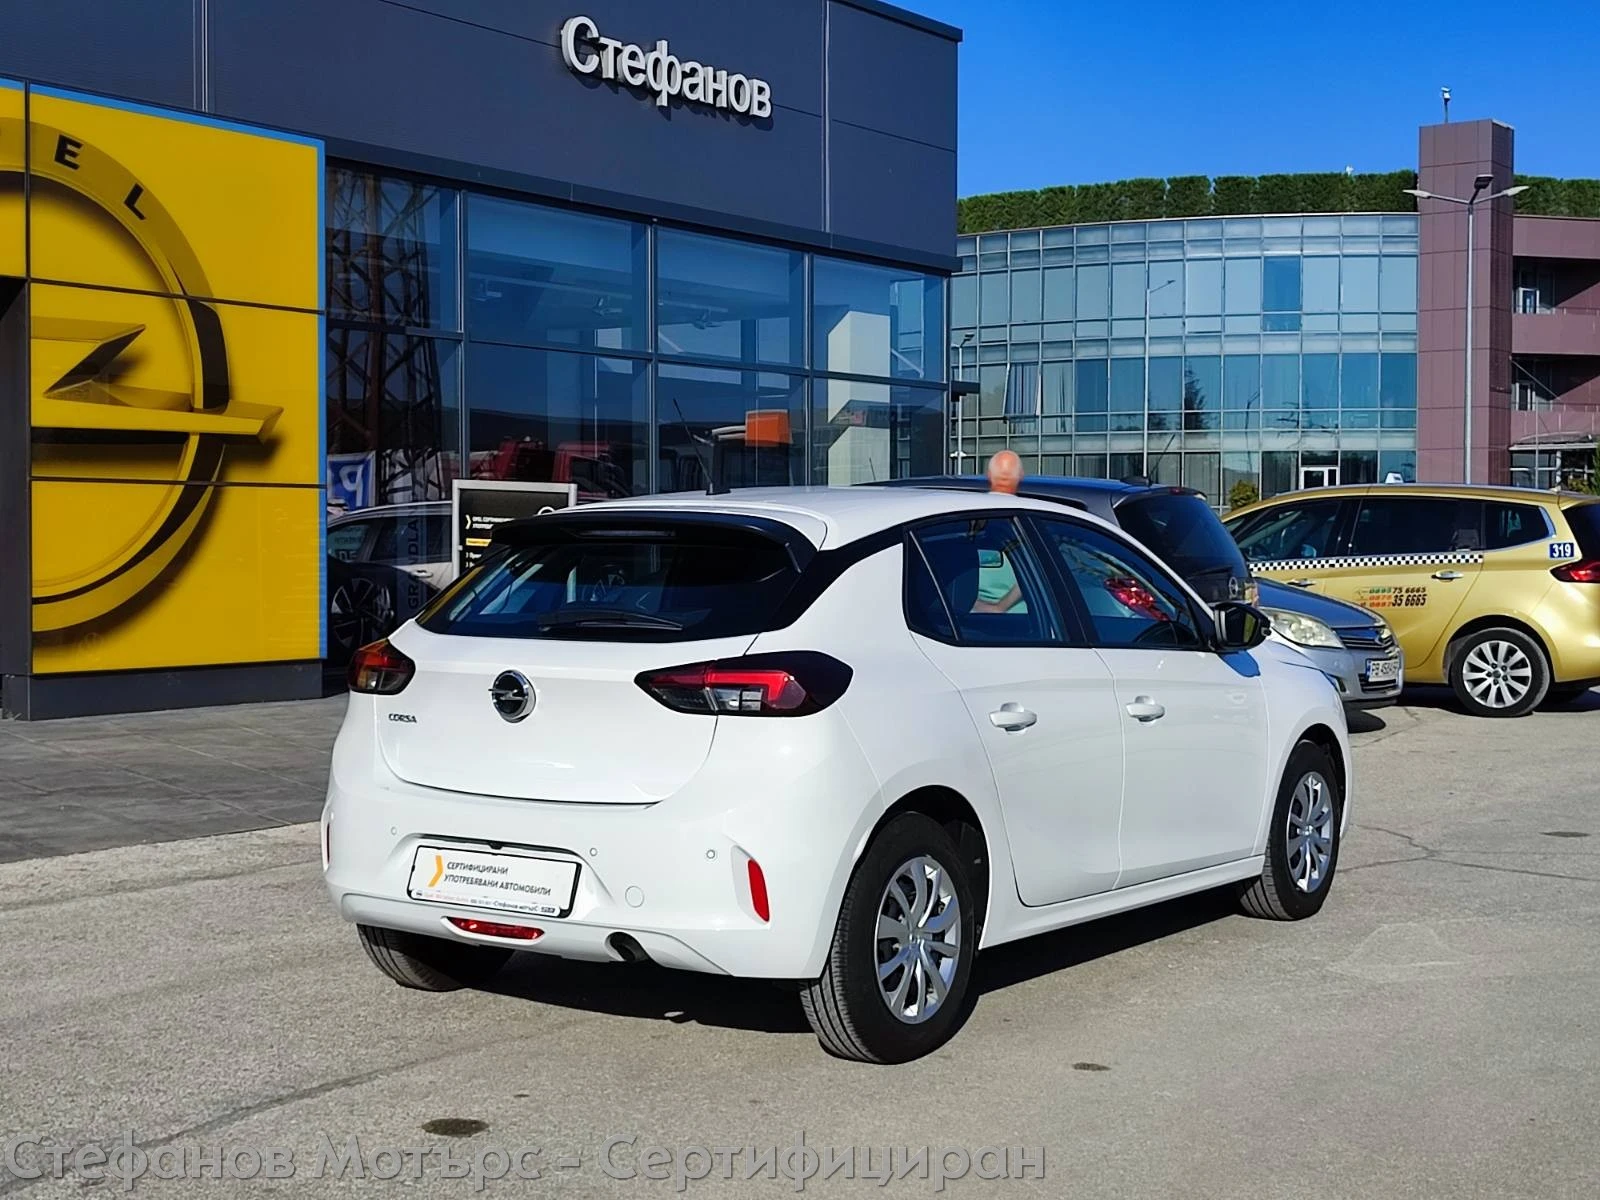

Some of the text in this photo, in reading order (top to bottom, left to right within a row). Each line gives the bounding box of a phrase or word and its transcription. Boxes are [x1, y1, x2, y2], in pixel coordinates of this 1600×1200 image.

[561, 16, 772, 118] Стефанов
[1552, 543, 1571, 557] 319
[1392, 594, 1404, 607] 35
[1405, 594, 1427, 607] 6665
[388, 713, 417, 723] CORSA
[447, 861, 509, 875] СЕРТИФИЦИРАНИ
[444, 874, 552, 896] УПОТРЕБЯВАНИ АВТОМОБИЛИ
